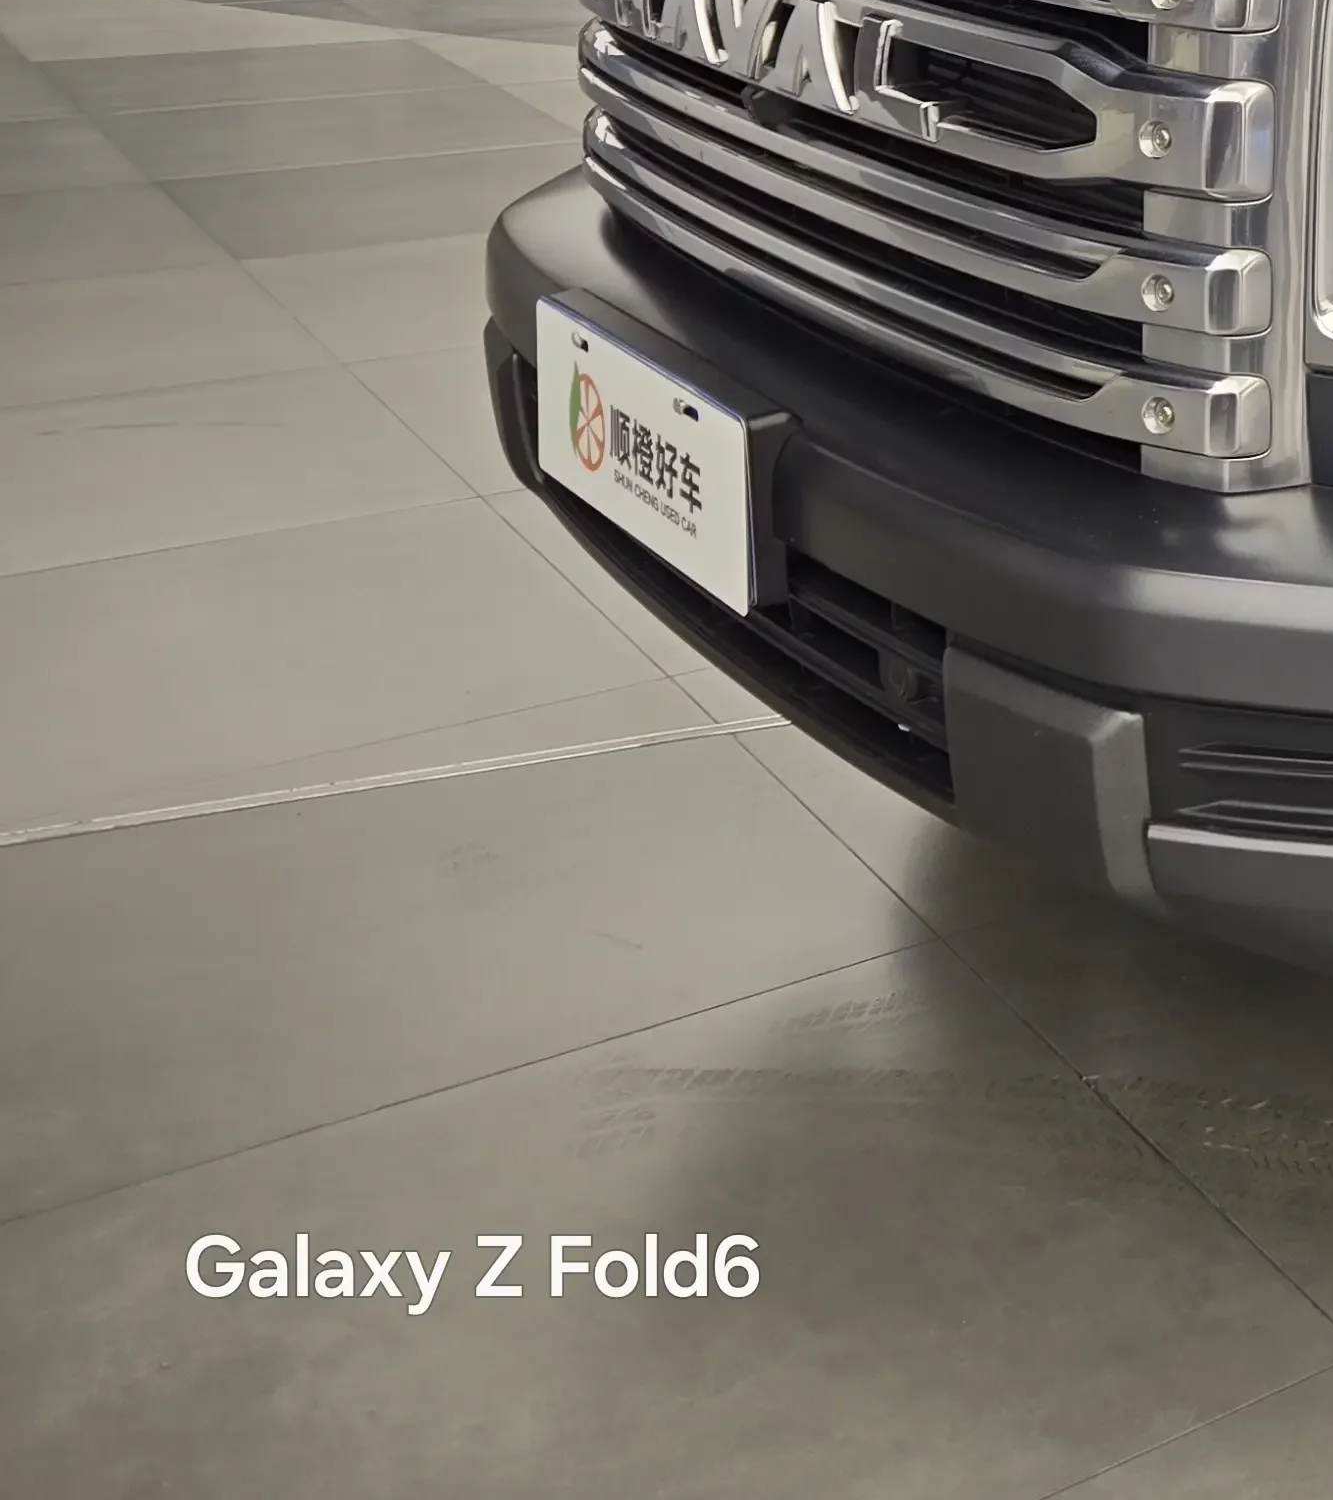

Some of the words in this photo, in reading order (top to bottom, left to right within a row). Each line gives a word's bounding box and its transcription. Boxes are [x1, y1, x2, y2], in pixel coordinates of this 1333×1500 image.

[609, 403, 702, 515] 顺橙好车
[614, 468, 633, 494] SHUN
[634, 483, 660, 512] CHENG
[660, 501, 680, 526] USED
[680, 516, 698, 539] CAR
